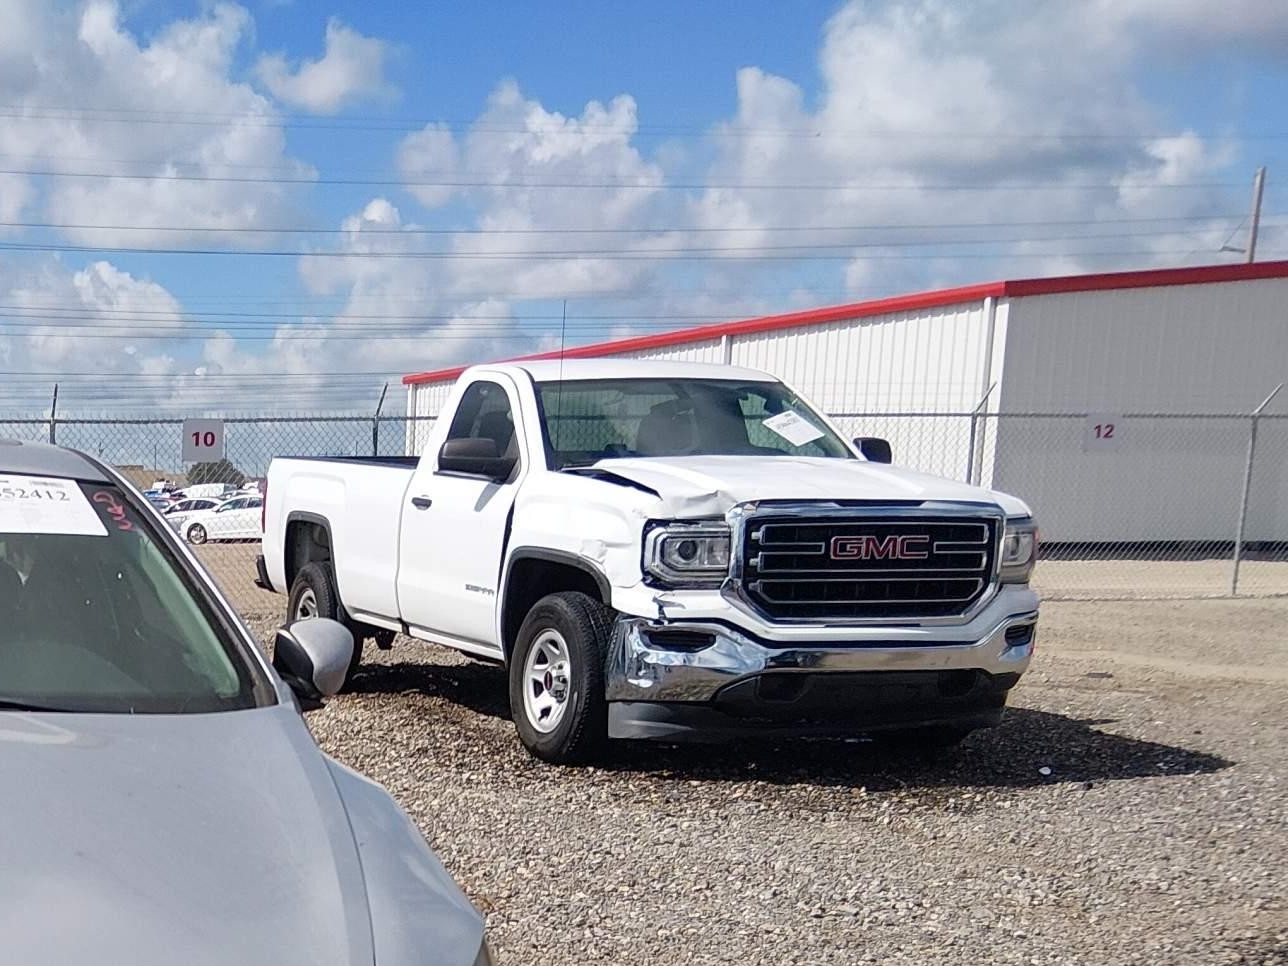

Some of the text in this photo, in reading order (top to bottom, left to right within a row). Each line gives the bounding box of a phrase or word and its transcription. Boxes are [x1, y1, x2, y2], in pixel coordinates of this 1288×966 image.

[191, 431, 216, 448] 10
[1094, 424, 1115, 439] 12
[830, 535, 930, 560] GMC
